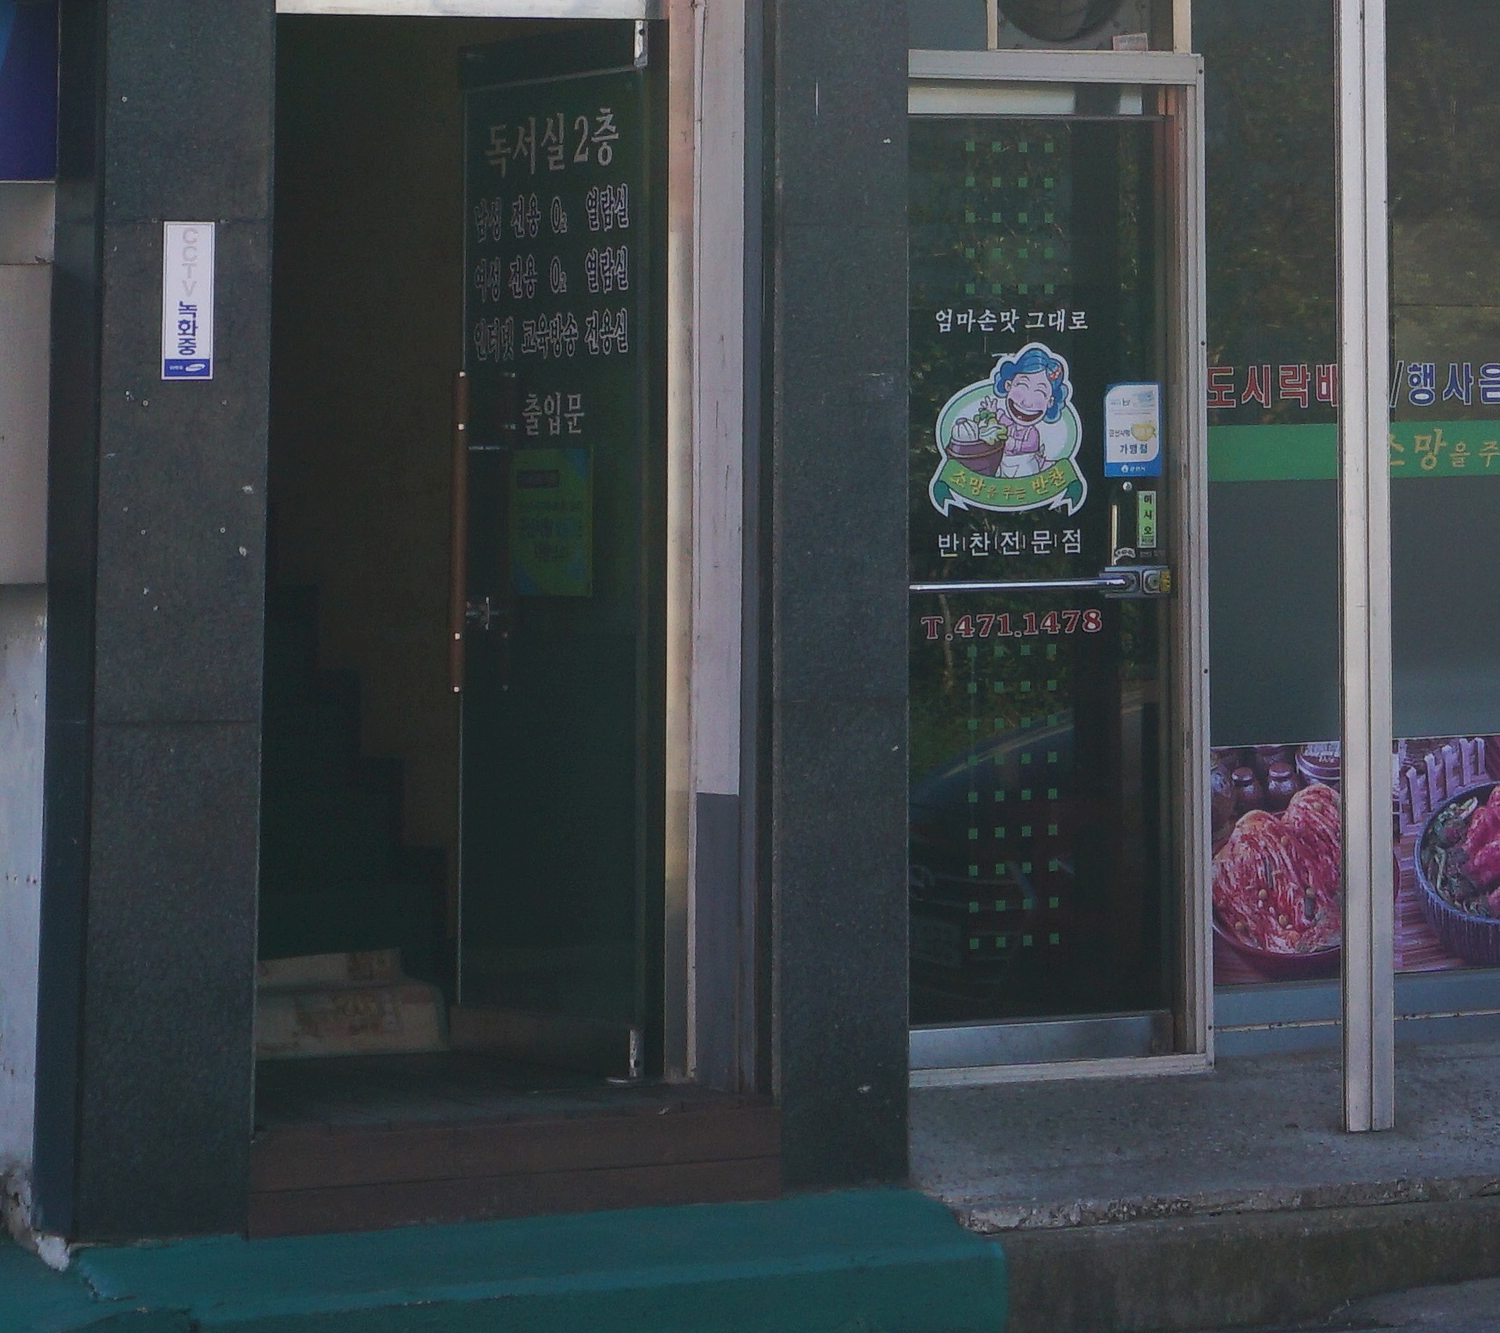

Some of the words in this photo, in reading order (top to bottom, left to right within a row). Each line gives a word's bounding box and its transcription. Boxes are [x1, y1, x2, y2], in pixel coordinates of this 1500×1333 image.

[484, 113, 566, 179] 독서실
[573, 107, 619, 166] 2층
[510, 193, 542, 239] 전용
[585, 183, 630, 233] 열람실
[508, 255, 538, 300] 전용
[584, 245, 630, 295] 열람실
[520, 311, 579, 358] 교육방송
[935, 308, 1021, 335] 엄마손맛
[1025, 309, 1090, 332] 그대로
[522, 392, 586, 436] 출입문
[1031, 468, 1067, 495] 반찬
